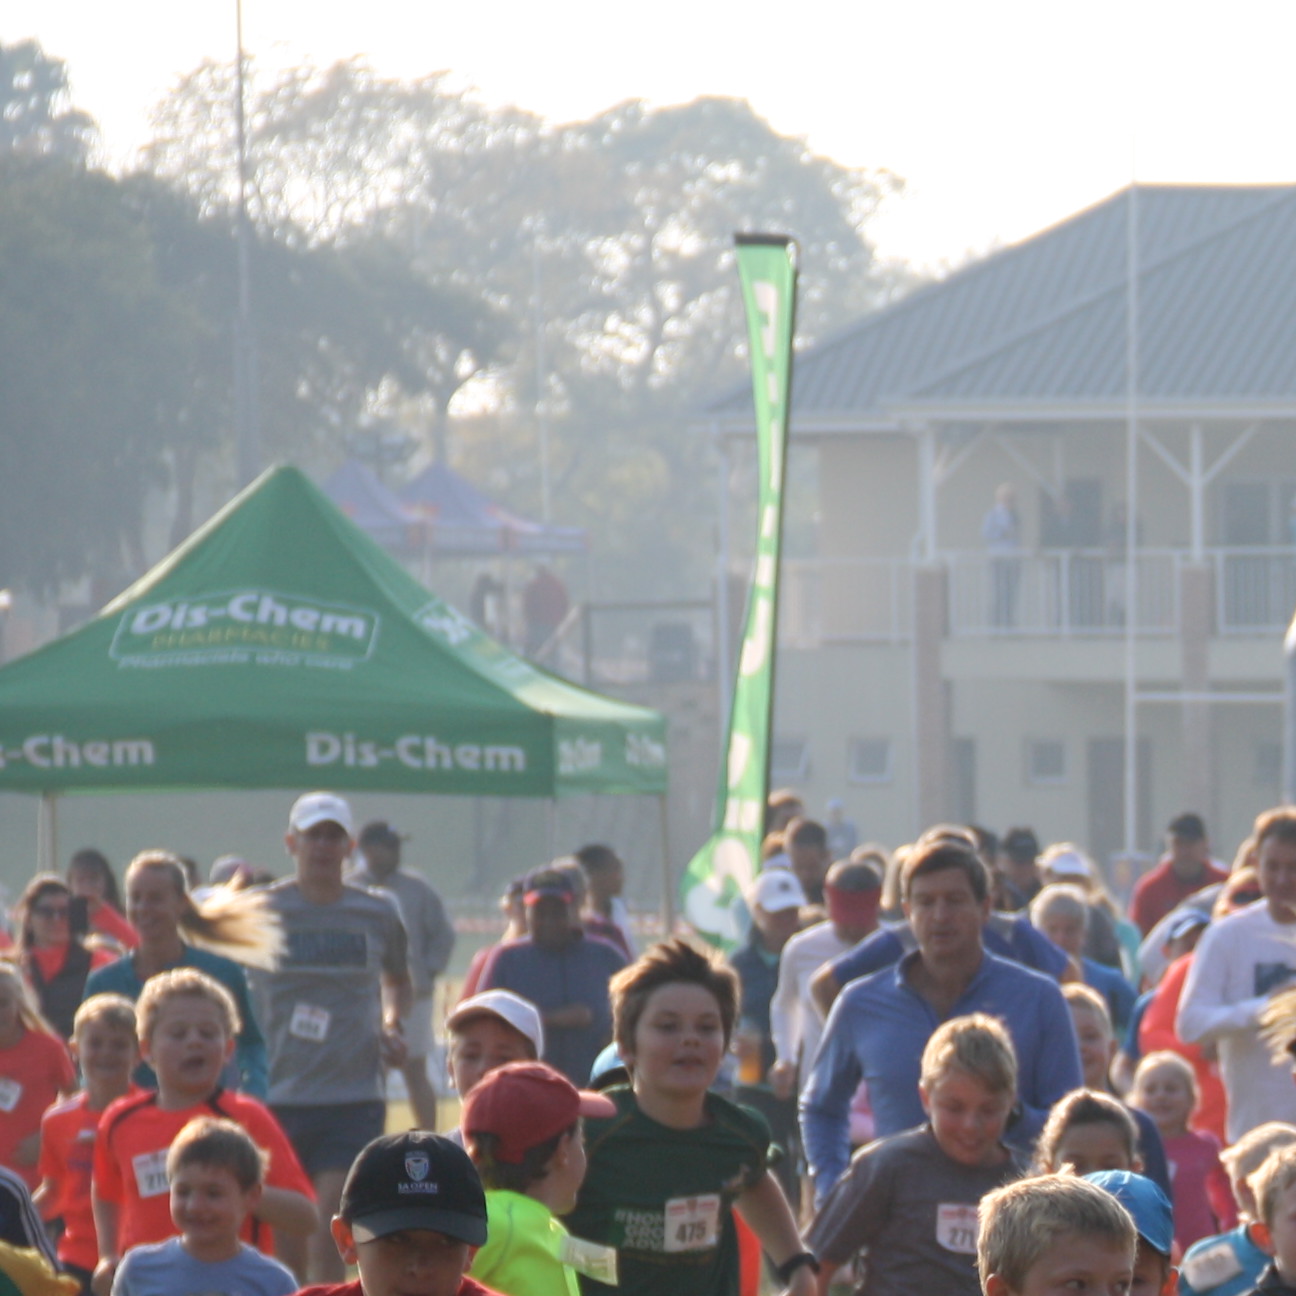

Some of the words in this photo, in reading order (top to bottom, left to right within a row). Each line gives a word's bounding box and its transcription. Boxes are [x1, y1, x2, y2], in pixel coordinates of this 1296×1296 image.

[130, 593, 367, 639] Dis-Chem
[0, 734, 155, 769] -Chem
[306, 731, 527, 772] Dis-Chem
[676, 1220, 707, 1244] 475
